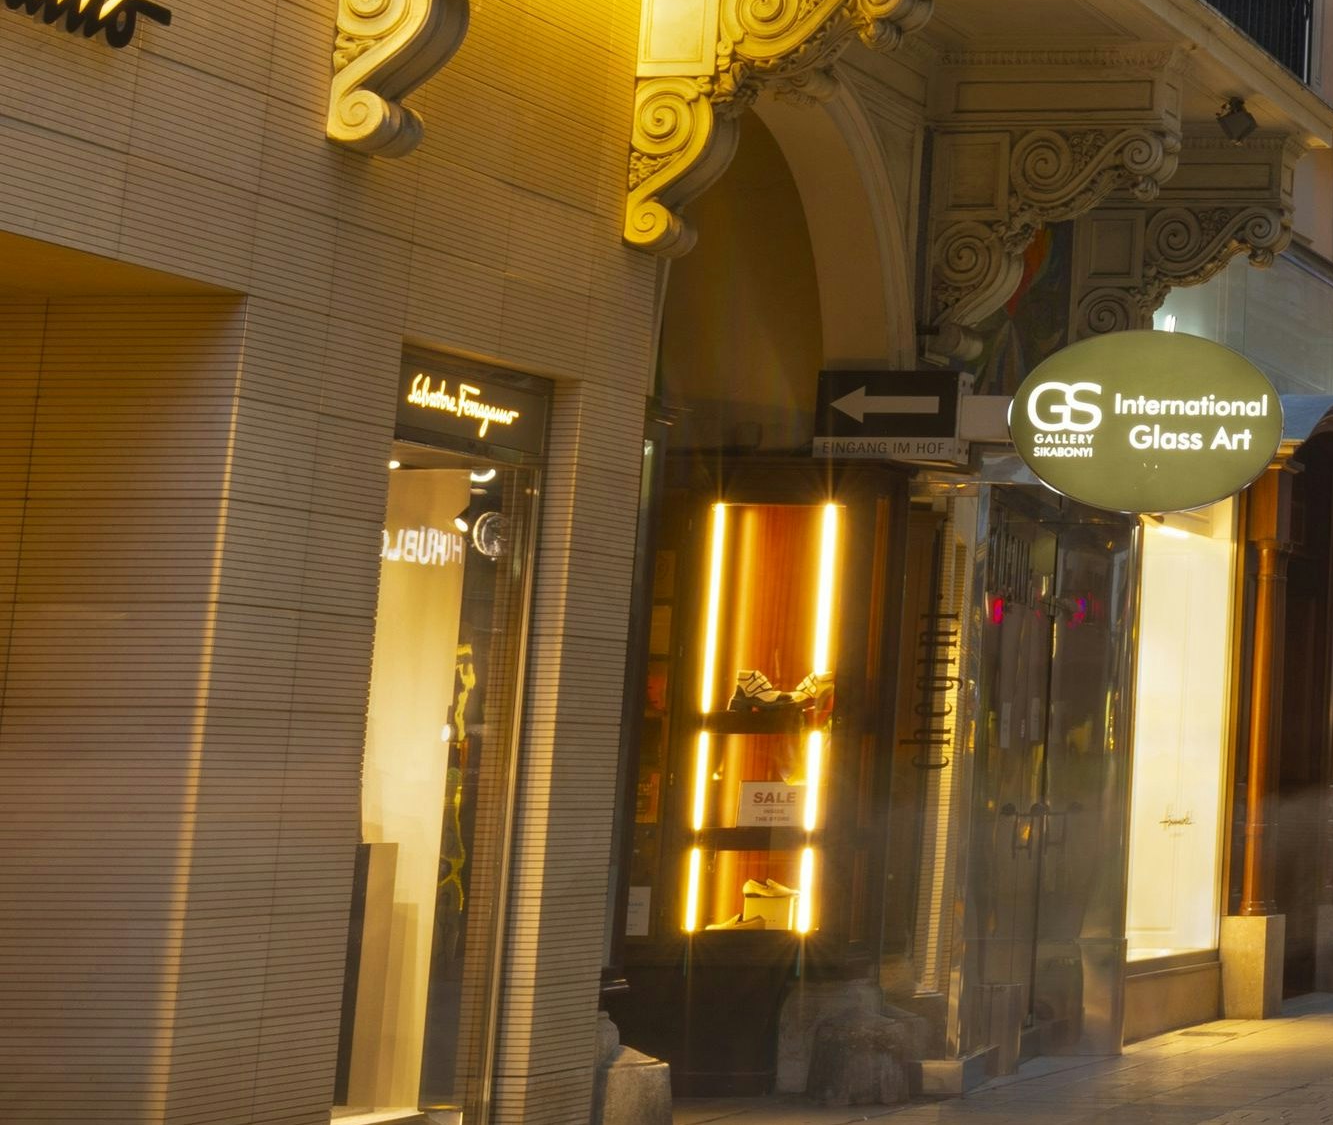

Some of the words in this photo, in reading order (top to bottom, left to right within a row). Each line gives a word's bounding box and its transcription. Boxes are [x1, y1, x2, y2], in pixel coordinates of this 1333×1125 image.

[408, 374, 457, 413] Salvatore
[457, 383, 519, 438] Ferragamo
[1027, 381, 1103, 433] GS
[1115, 393, 1268, 417] International
[1034, 433, 1094, 445] GALLERY
[1129, 424, 1203, 450] Glass
[1210, 426, 1252, 450] Art
[822, 441, 887, 454] EINGANG
[893, 443, 910, 454] IM
[916, 442, 945, 455] HOF
[1033, 446, 1093, 458] SIKABONYI
[753, 791, 797, 804] SALE
